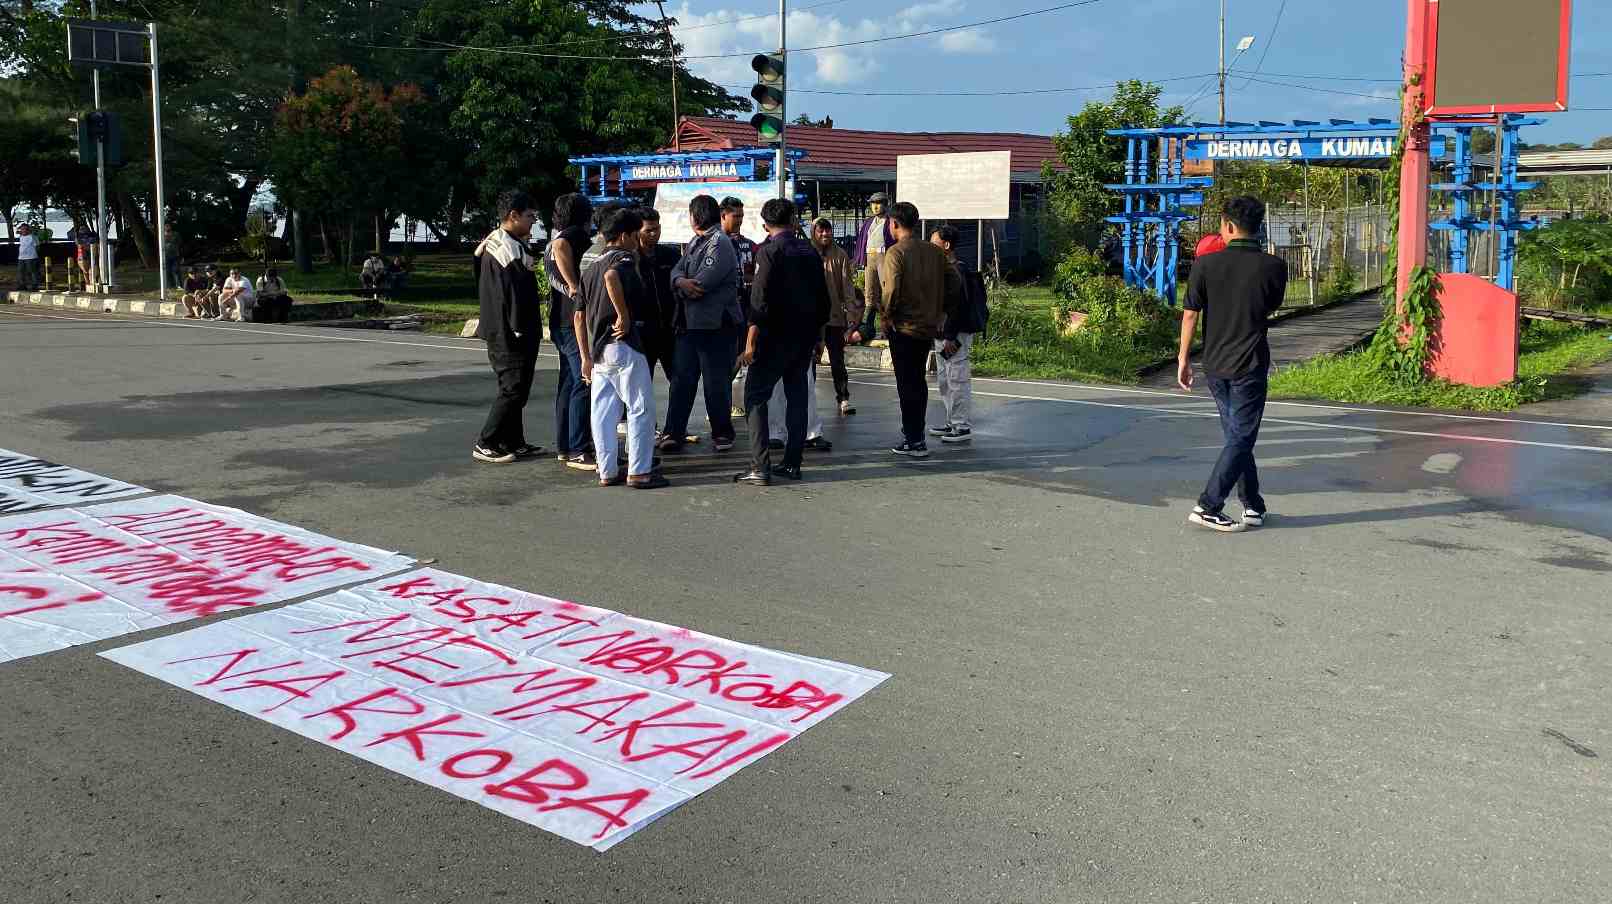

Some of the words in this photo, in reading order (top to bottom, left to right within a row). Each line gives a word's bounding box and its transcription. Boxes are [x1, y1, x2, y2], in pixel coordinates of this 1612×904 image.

[1207, 140, 1303, 158] DERMAGA
[1322, 138, 1399, 156] KUMAL
[632, 165, 682, 179] DERMAGA
[690, 162, 737, 177] KUMALA
[378, 577, 600, 641] KASAT
[169, 647, 650, 840] NARKOBA
